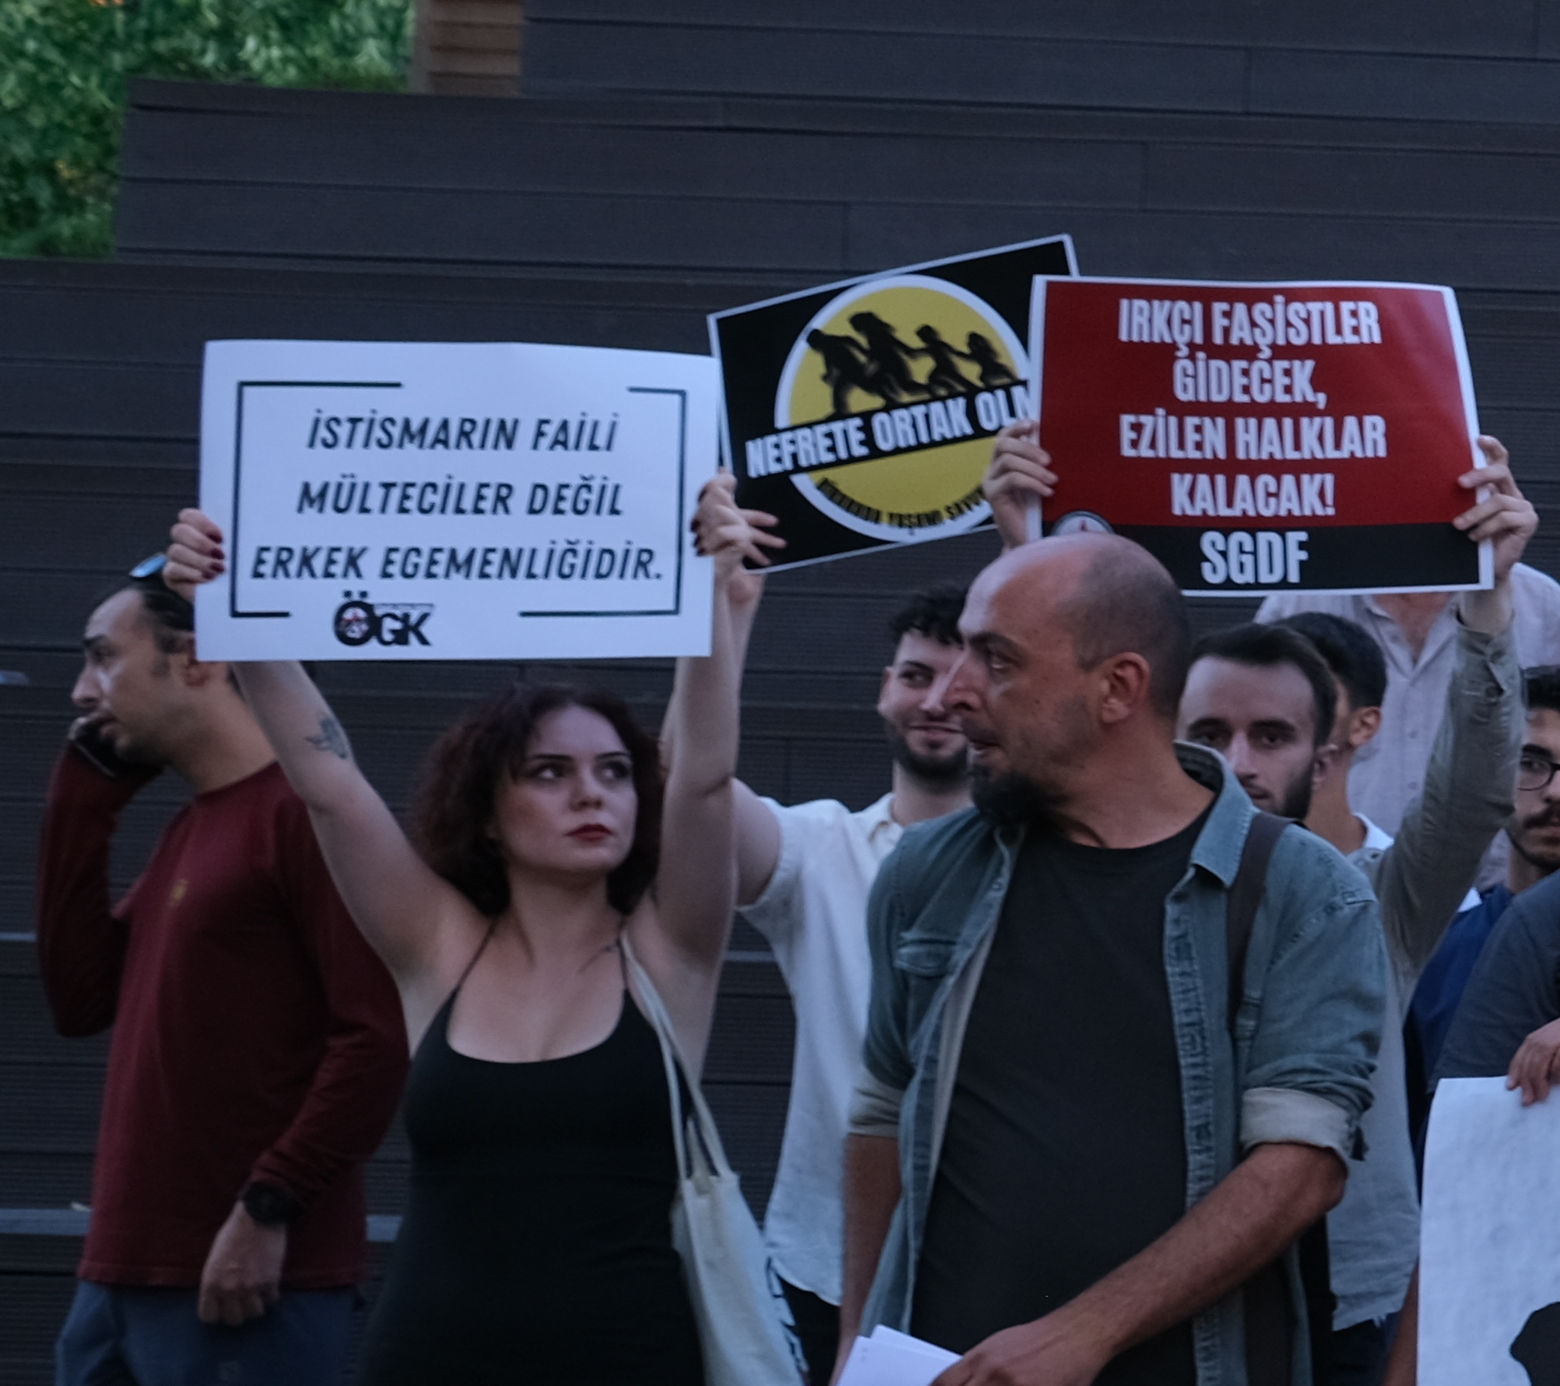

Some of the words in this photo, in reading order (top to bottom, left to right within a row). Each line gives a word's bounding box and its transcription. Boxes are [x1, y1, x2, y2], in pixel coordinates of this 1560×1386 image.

[1118, 298, 1204, 358] IRKÇI
[1211, 294, 1383, 360] FAŞİSTLER
[1172, 351, 1328, 410] GİDECEK,
[307, 408, 519, 452] İSTİSMARIN
[530, 412, 620, 454] FAİLİ
[745, 418, 870, 480] NEFRETE
[871, 396, 975, 452] ORTAK
[1119, 407, 1227, 460] EZİLEN
[1235, 414, 1388, 460] HALKLAR
[296, 474, 513, 516] MÜLTECİLER
[526, 473, 624, 517] DEĞİL
[1170, 473, 1336, 517] KALACAK!
[251, 546, 369, 580] ERKEK
[379, 539, 664, 582] EGEMENLİĞİDİR.
[1200, 530, 1309, 584] SGDF
[334, 589, 433, 647] ÖGK
